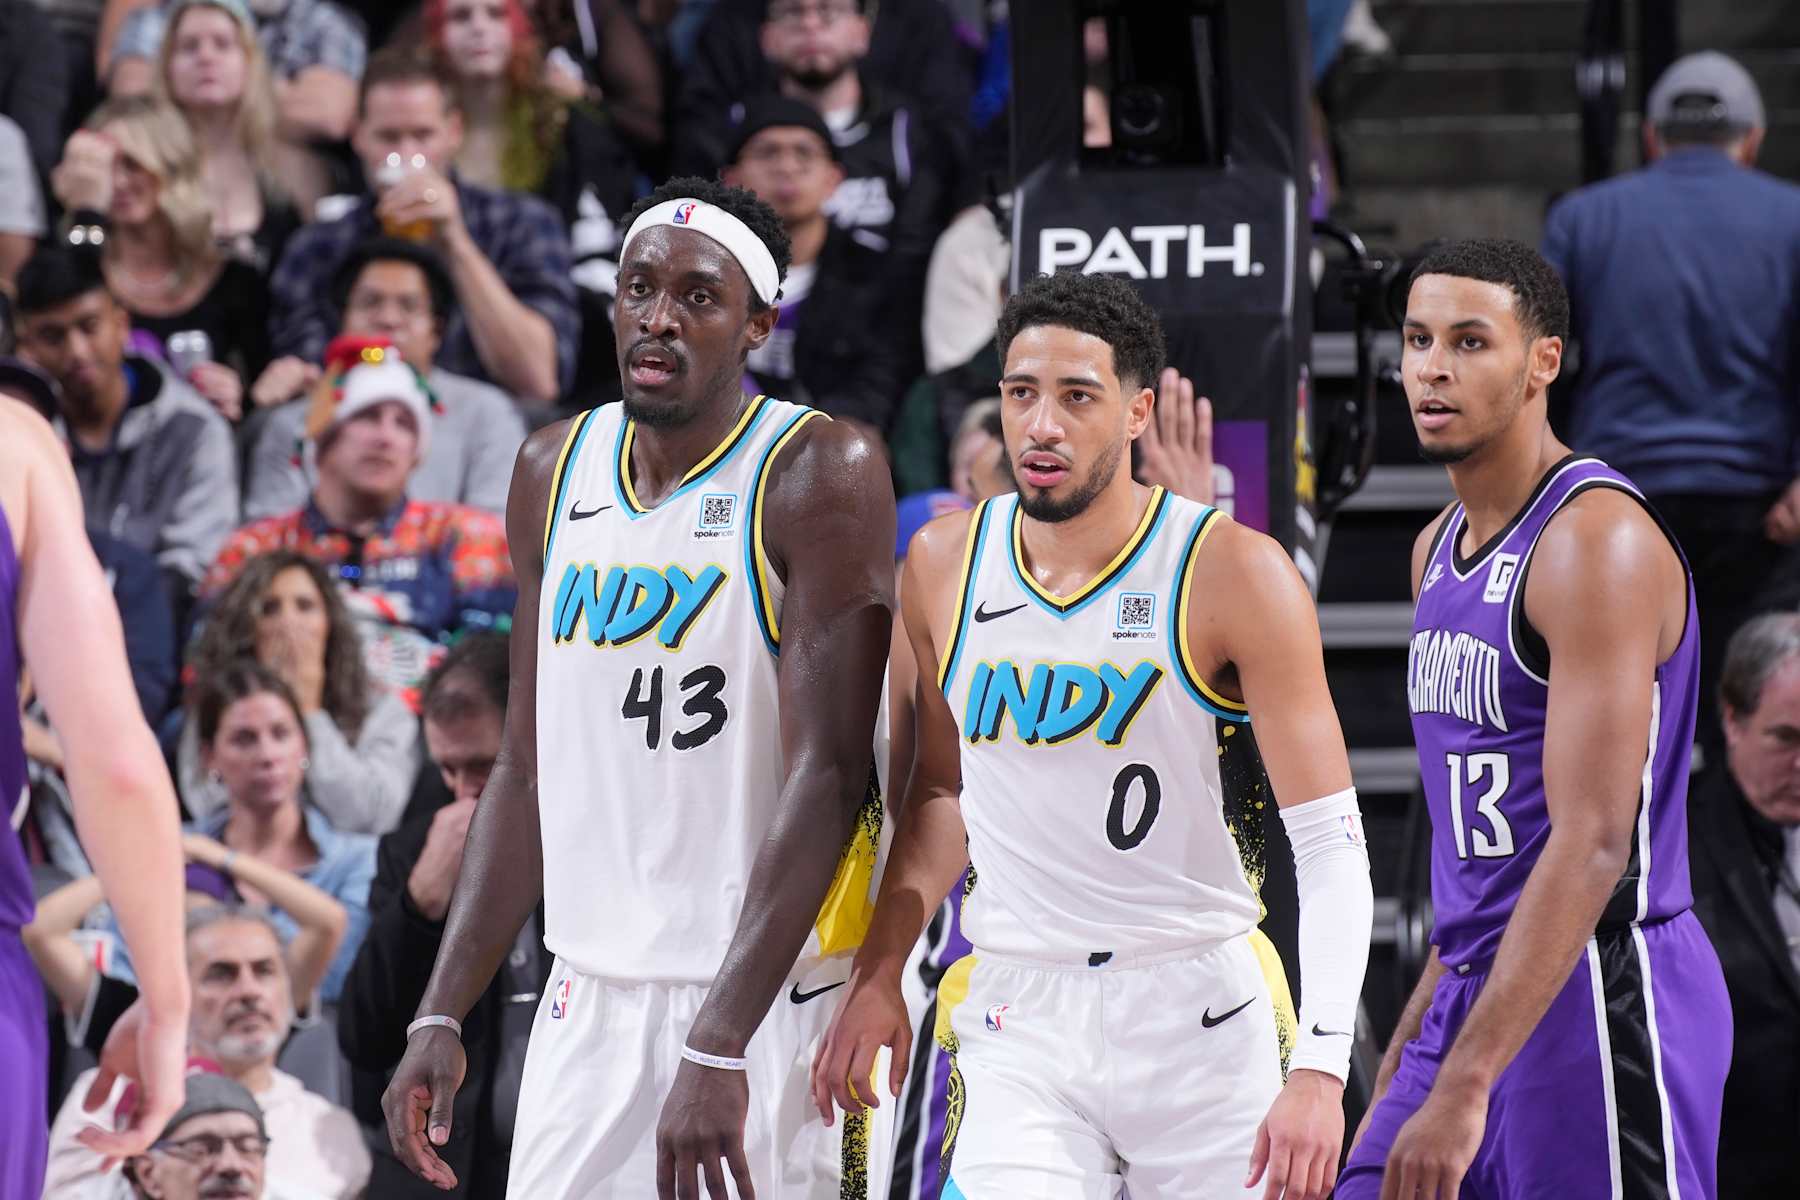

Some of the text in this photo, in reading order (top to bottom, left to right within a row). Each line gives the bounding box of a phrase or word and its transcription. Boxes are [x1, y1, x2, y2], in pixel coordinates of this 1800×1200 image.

[1039, 223, 1265, 279] PATH.
[552, 563, 730, 653] INDY
[1112, 630, 1157, 640] spokenote
[621, 664, 729, 751] 43
[964, 658, 1167, 749] INDY
[1105, 762, 1162, 852] 0
[1446, 752, 1515, 859] 13
